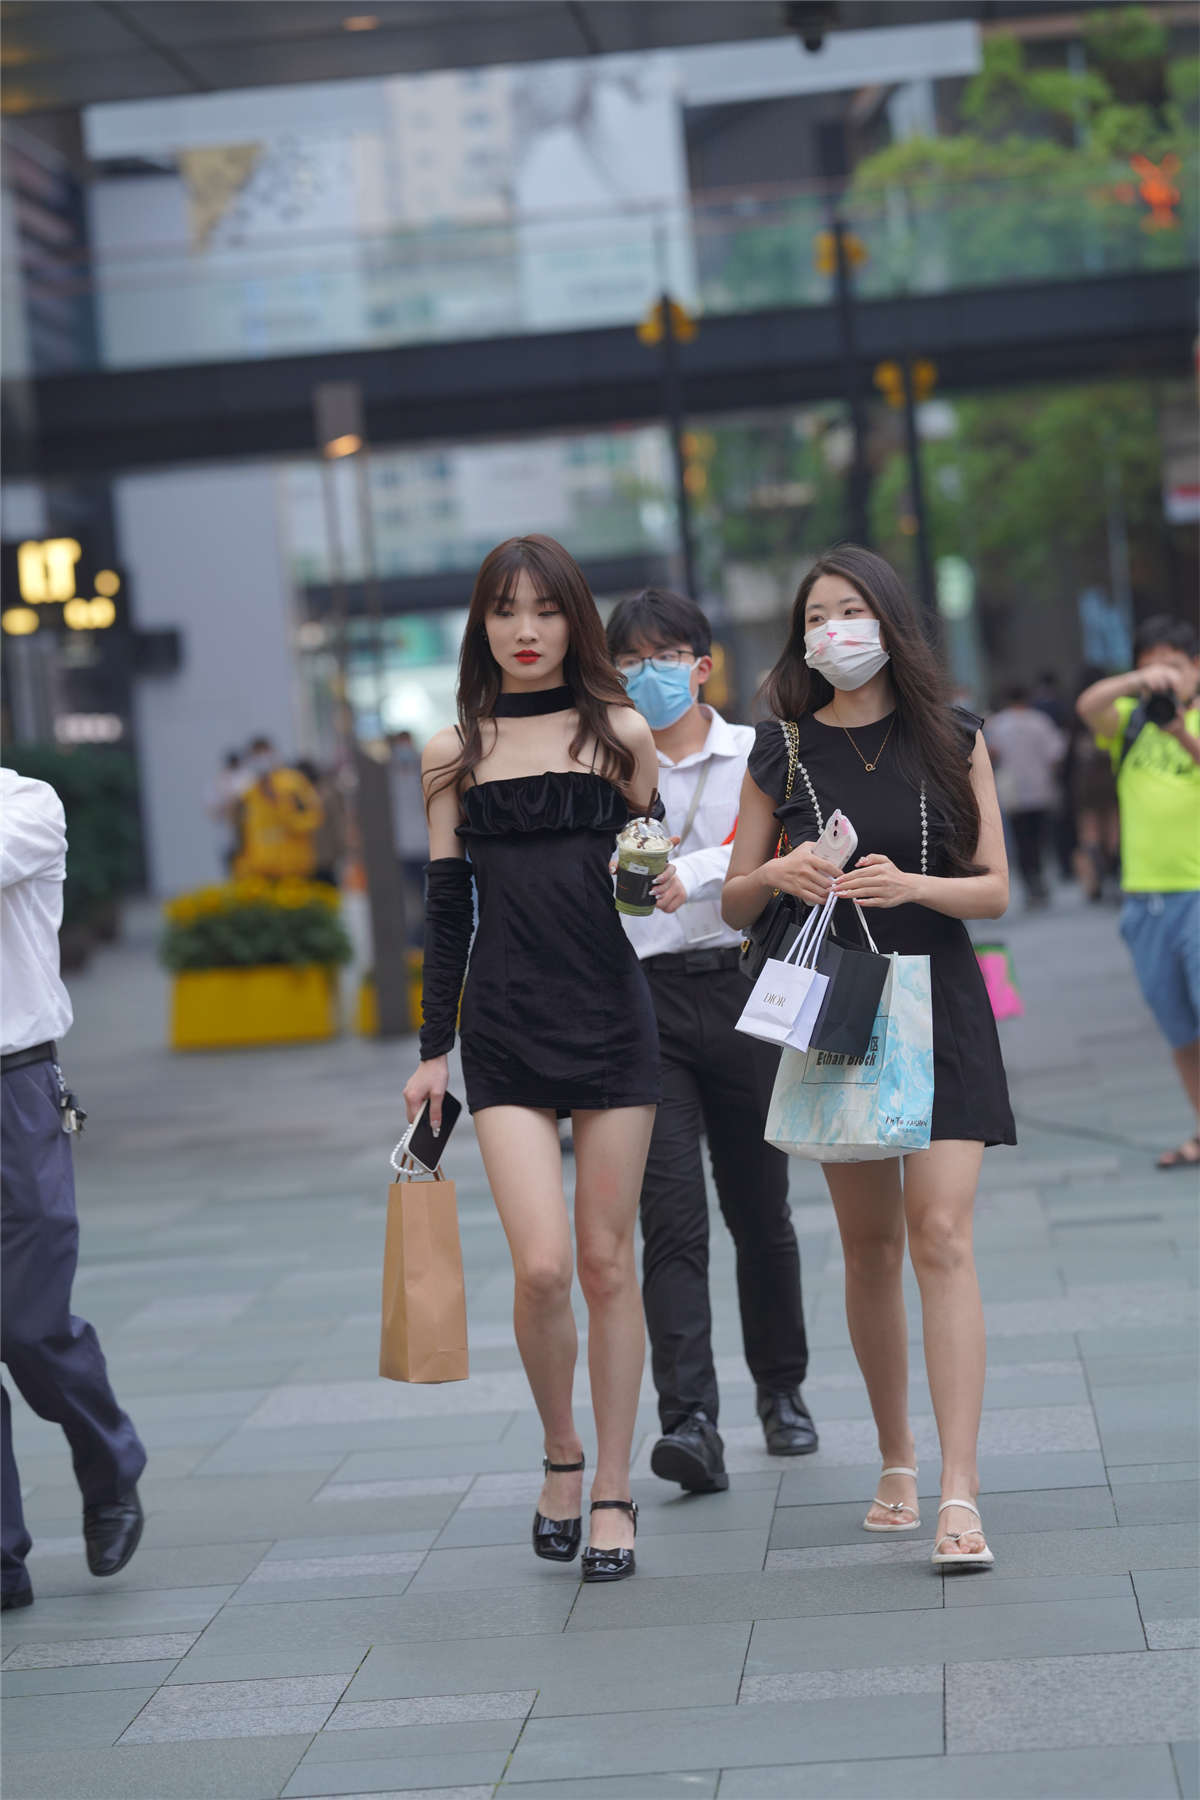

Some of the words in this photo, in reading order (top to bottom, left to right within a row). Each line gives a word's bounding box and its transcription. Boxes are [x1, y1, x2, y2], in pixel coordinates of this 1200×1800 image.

[763, 992, 786, 1008] DIOR
[816, 1051, 846, 1066] Ethan
[846, 1052, 877, 1066] Block
